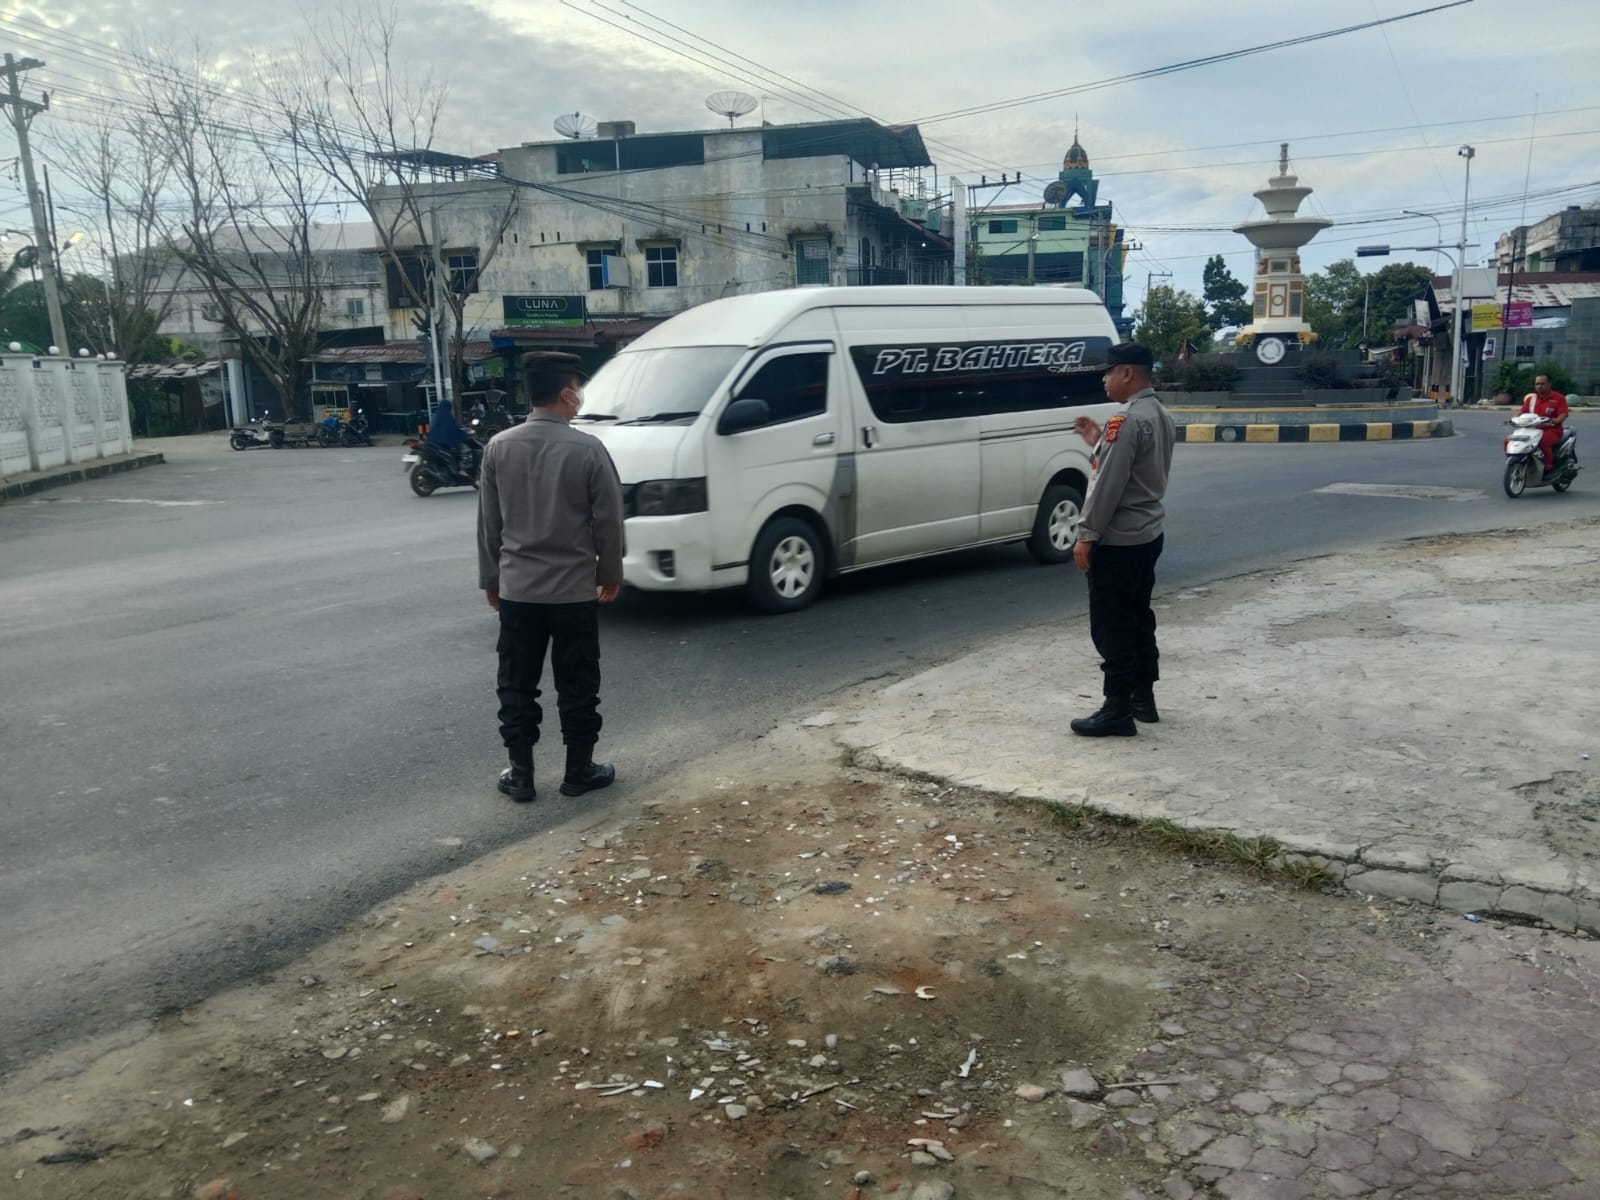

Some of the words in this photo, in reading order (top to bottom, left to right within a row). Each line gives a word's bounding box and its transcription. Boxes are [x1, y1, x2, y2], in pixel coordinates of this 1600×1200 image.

[525, 299, 559, 309] LUNA
[872, 348, 929, 374] PT.
[932, 341, 1086, 372] BAHTERA
